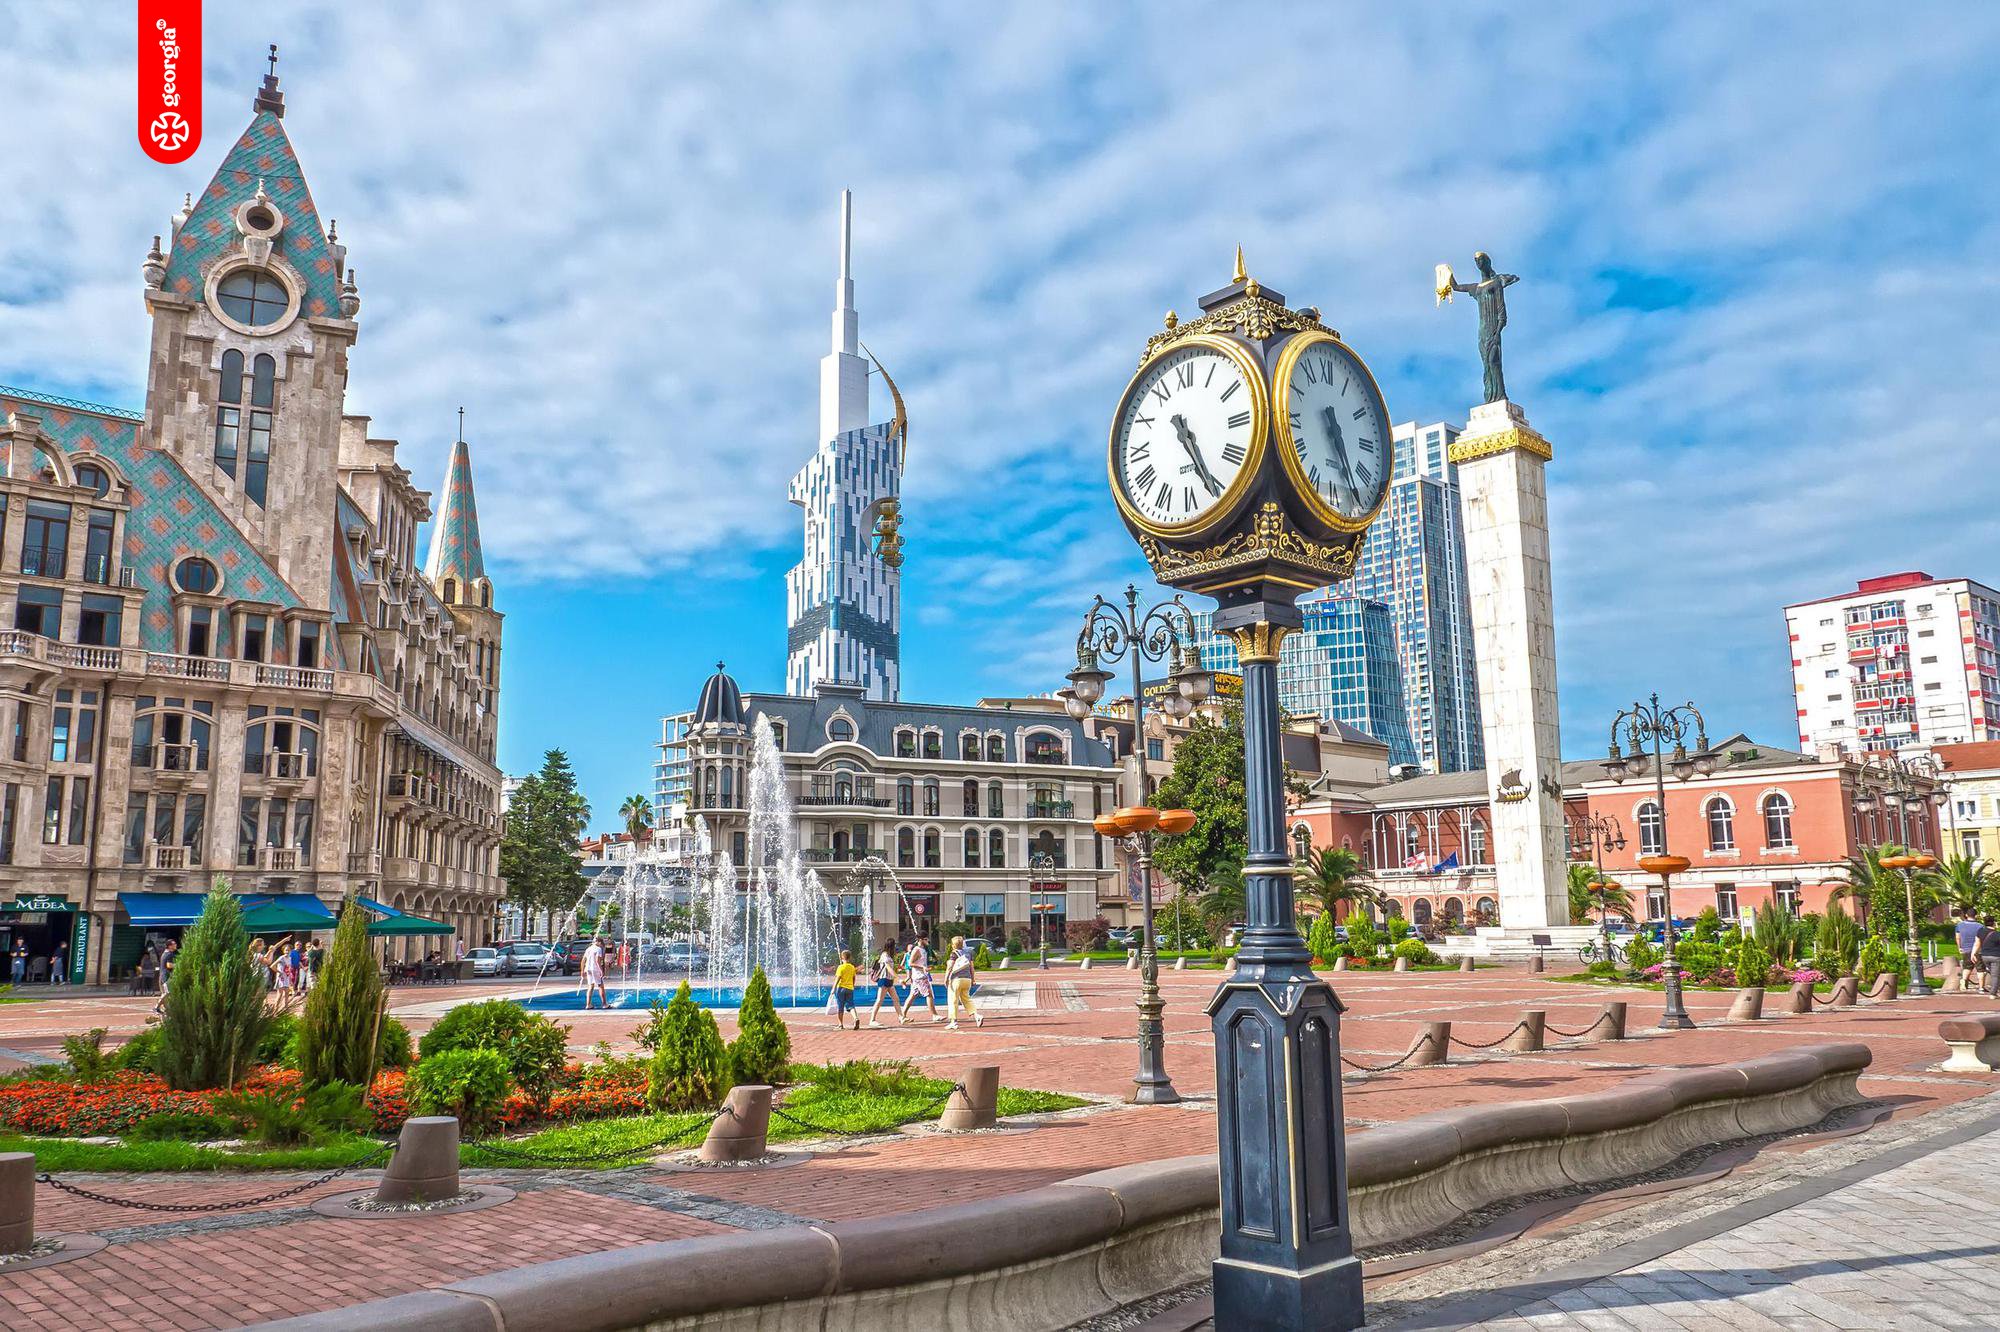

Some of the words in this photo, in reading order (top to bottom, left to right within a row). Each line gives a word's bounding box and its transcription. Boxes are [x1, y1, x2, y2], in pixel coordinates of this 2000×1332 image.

[1176, 361, 1194, 392] XII
[1300, 358, 1317, 387] XI
[1319, 357, 1333, 386] XII
[1151, 379, 1172, 408] XI
[1220, 380, 1241, 403] II
[1135, 412, 1155, 430] X
[1228, 410, 1250, 429] III
[1352, 407, 1367, 421] II
[1130, 441, 1150, 464] IX
[1358, 437, 1374, 454] III
[1135, 464, 1158, 497] VIII
[1155, 482, 1173, 512] VII
[1184, 485, 1198, 513] VI
[16, 899, 68, 911] MEDEA
[76, 917, 88, 973] RESTAURANT
